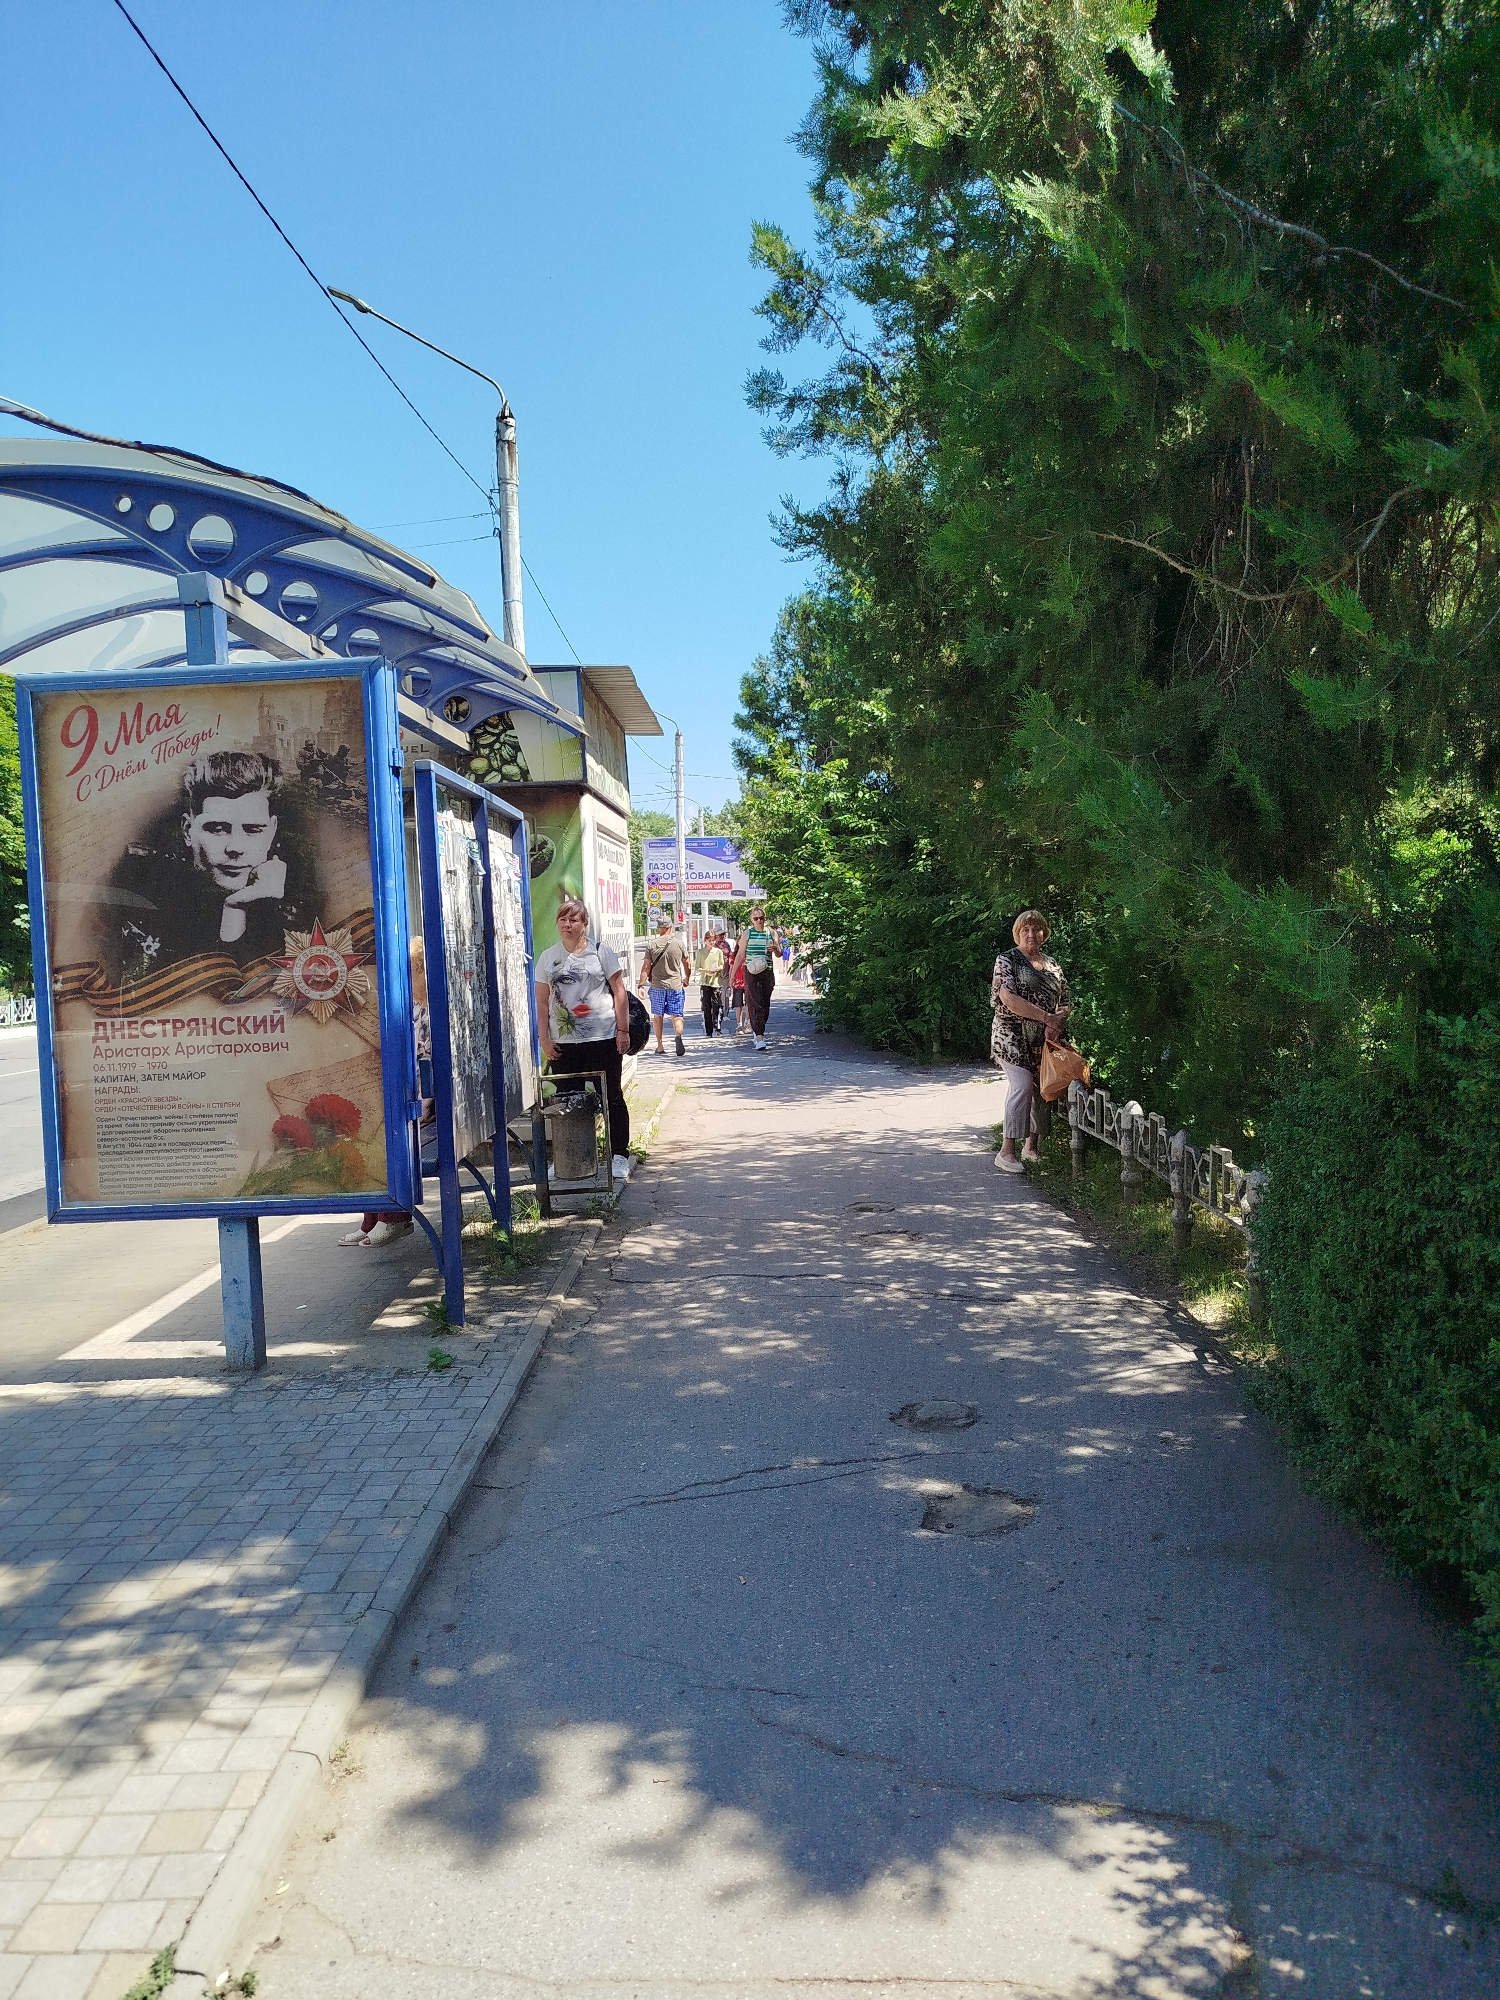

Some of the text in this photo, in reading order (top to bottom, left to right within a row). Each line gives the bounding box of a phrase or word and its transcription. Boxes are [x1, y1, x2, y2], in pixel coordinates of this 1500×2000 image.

[60, 702, 188, 777] 9 Мая
[400, 744, 429, 753] UEL
[76, 713, 221, 802] С Днём Победы!
[91, 1010, 286, 1044] ДНЕСТРЯНСКИЙ
[93, 1041, 289, 1061] Аристарх Аристархович
[93, 1062, 137, 1072] 06.11.1919
[147, 1061, 168, 1071] 1970
[94, 1070, 207, 1084] КАПИТАН, ЗАТЕМ МАЙОР
[94, 1086, 141, 1095] НАГРАДЫ:
[117, 1096, 152, 1104] «КРАСНОЙ
[153, 1095, 183, 1103] ЗВЕЗДЫ»
[211, 1101, 241, 1109] СТЕПЕНИ
